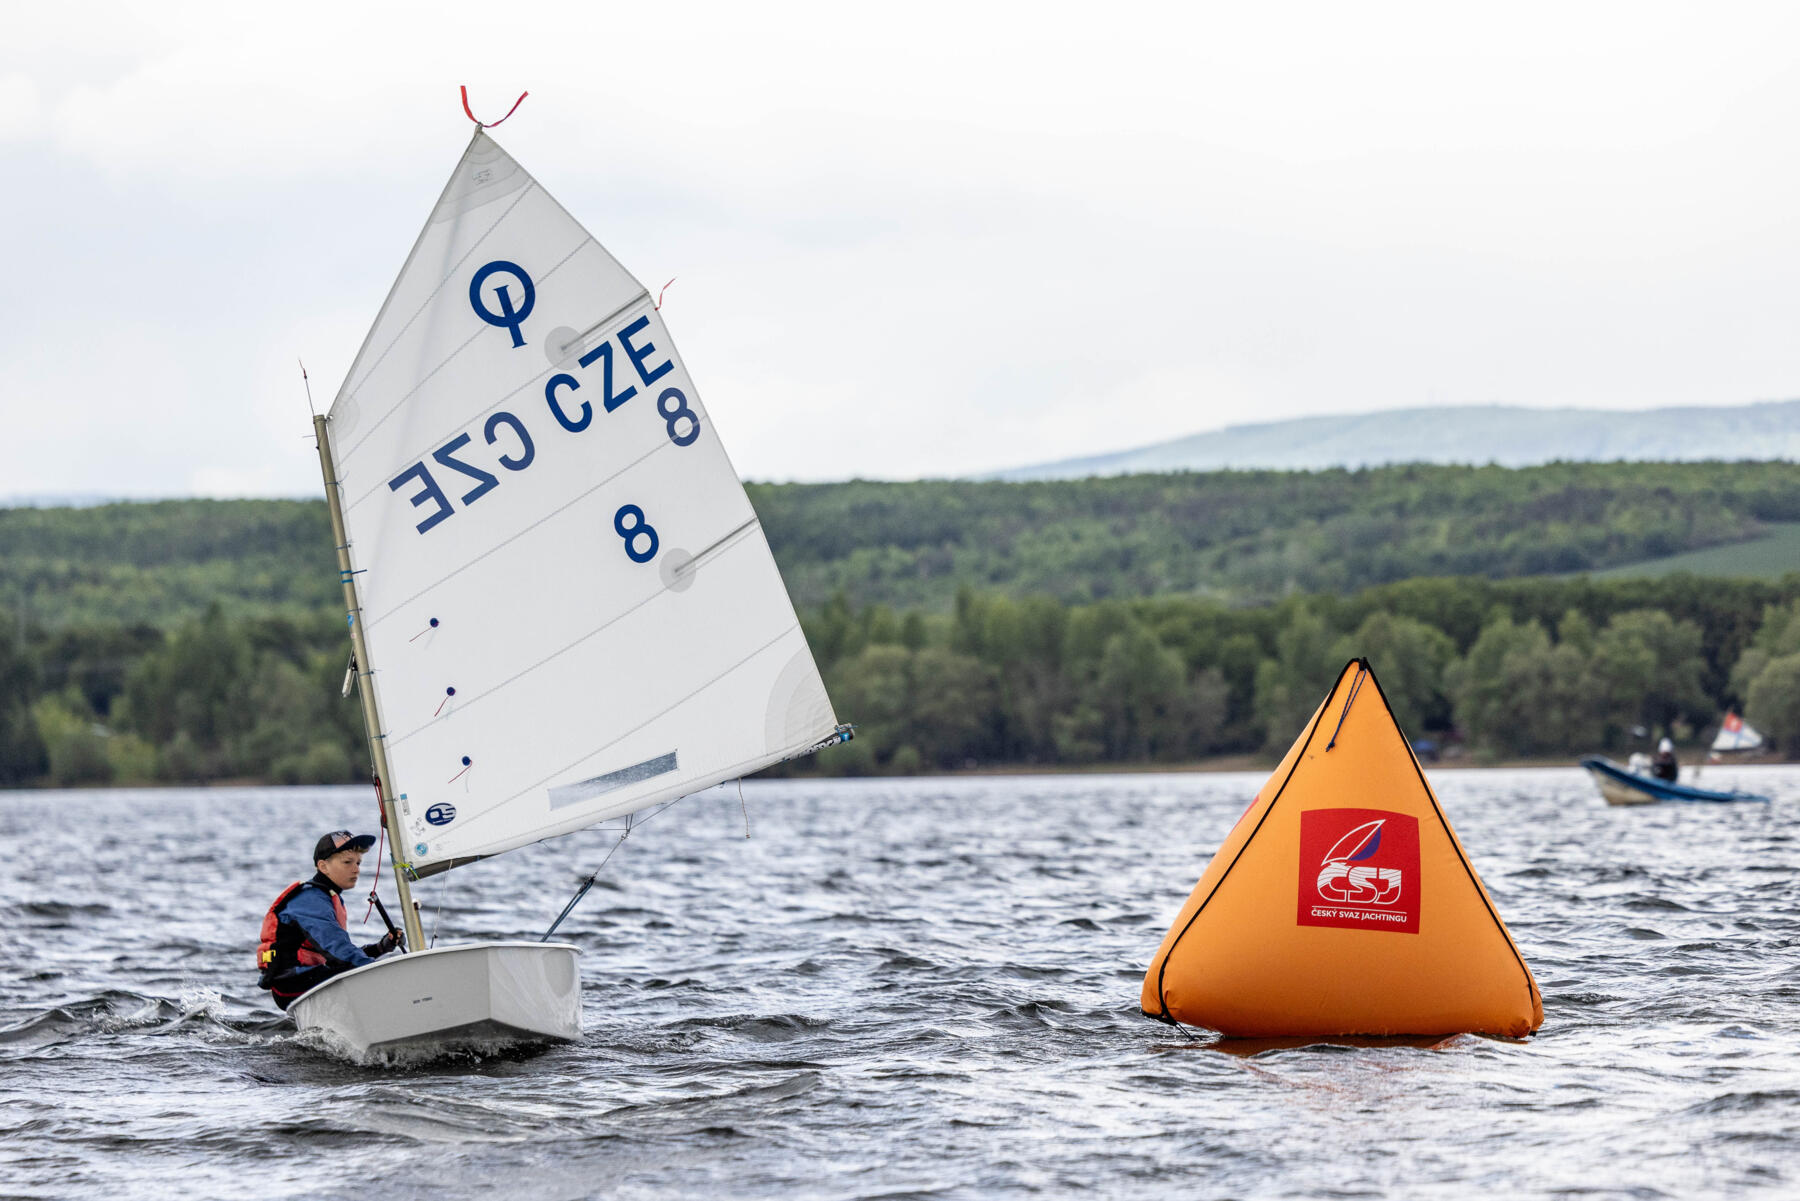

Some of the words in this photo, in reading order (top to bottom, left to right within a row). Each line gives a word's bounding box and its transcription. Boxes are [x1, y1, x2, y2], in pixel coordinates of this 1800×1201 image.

[545, 314, 675, 433] CZE
[613, 503, 659, 563] 8
[1311, 907, 1338, 917] ČESKÝ
[1339, 910, 1360, 919] SVAZ
[1361, 912, 1407, 922] JACHTINGU
